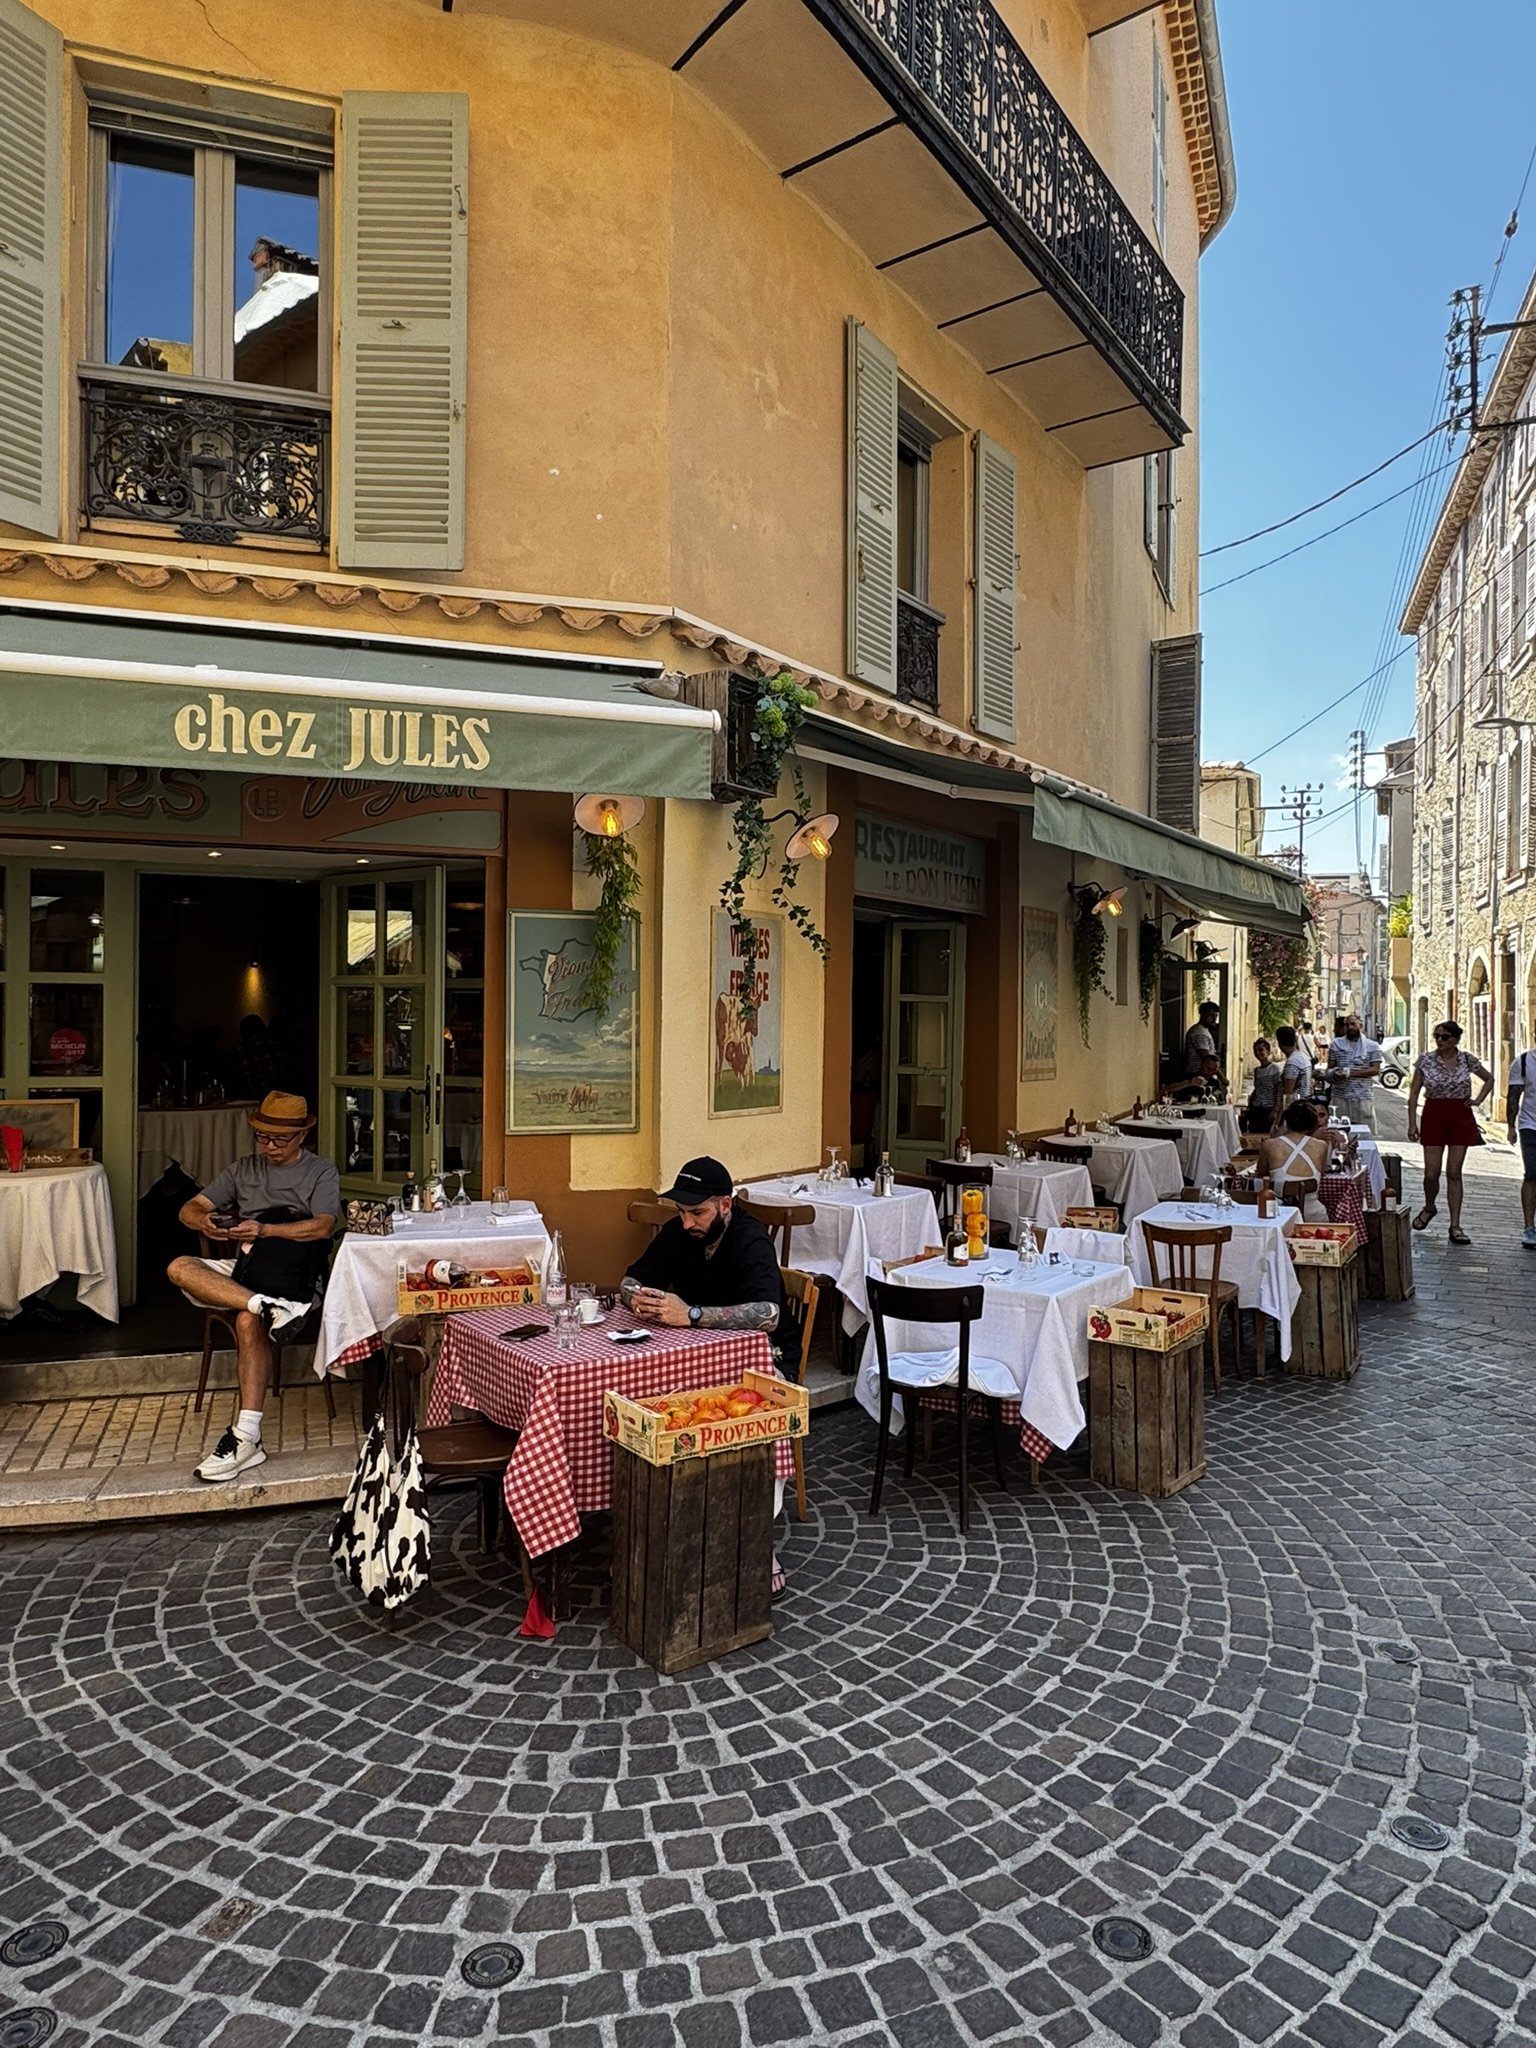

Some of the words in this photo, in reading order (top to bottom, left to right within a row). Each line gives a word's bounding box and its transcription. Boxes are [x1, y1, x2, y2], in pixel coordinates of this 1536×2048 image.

[174, 693, 317, 760] chez
[343, 707, 491, 772] JULES
[884, 869, 901, 891] LE
[905, 866, 939, 898] DON
[729, 924, 771, 961] VIDES
[729, 969, 770, 1002] FRNCE
[1034, 981, 1048, 1009] ICI
[437, 1290, 520, 1310] PROVENCE
[700, 1414, 788, 1455] PROVENCE
